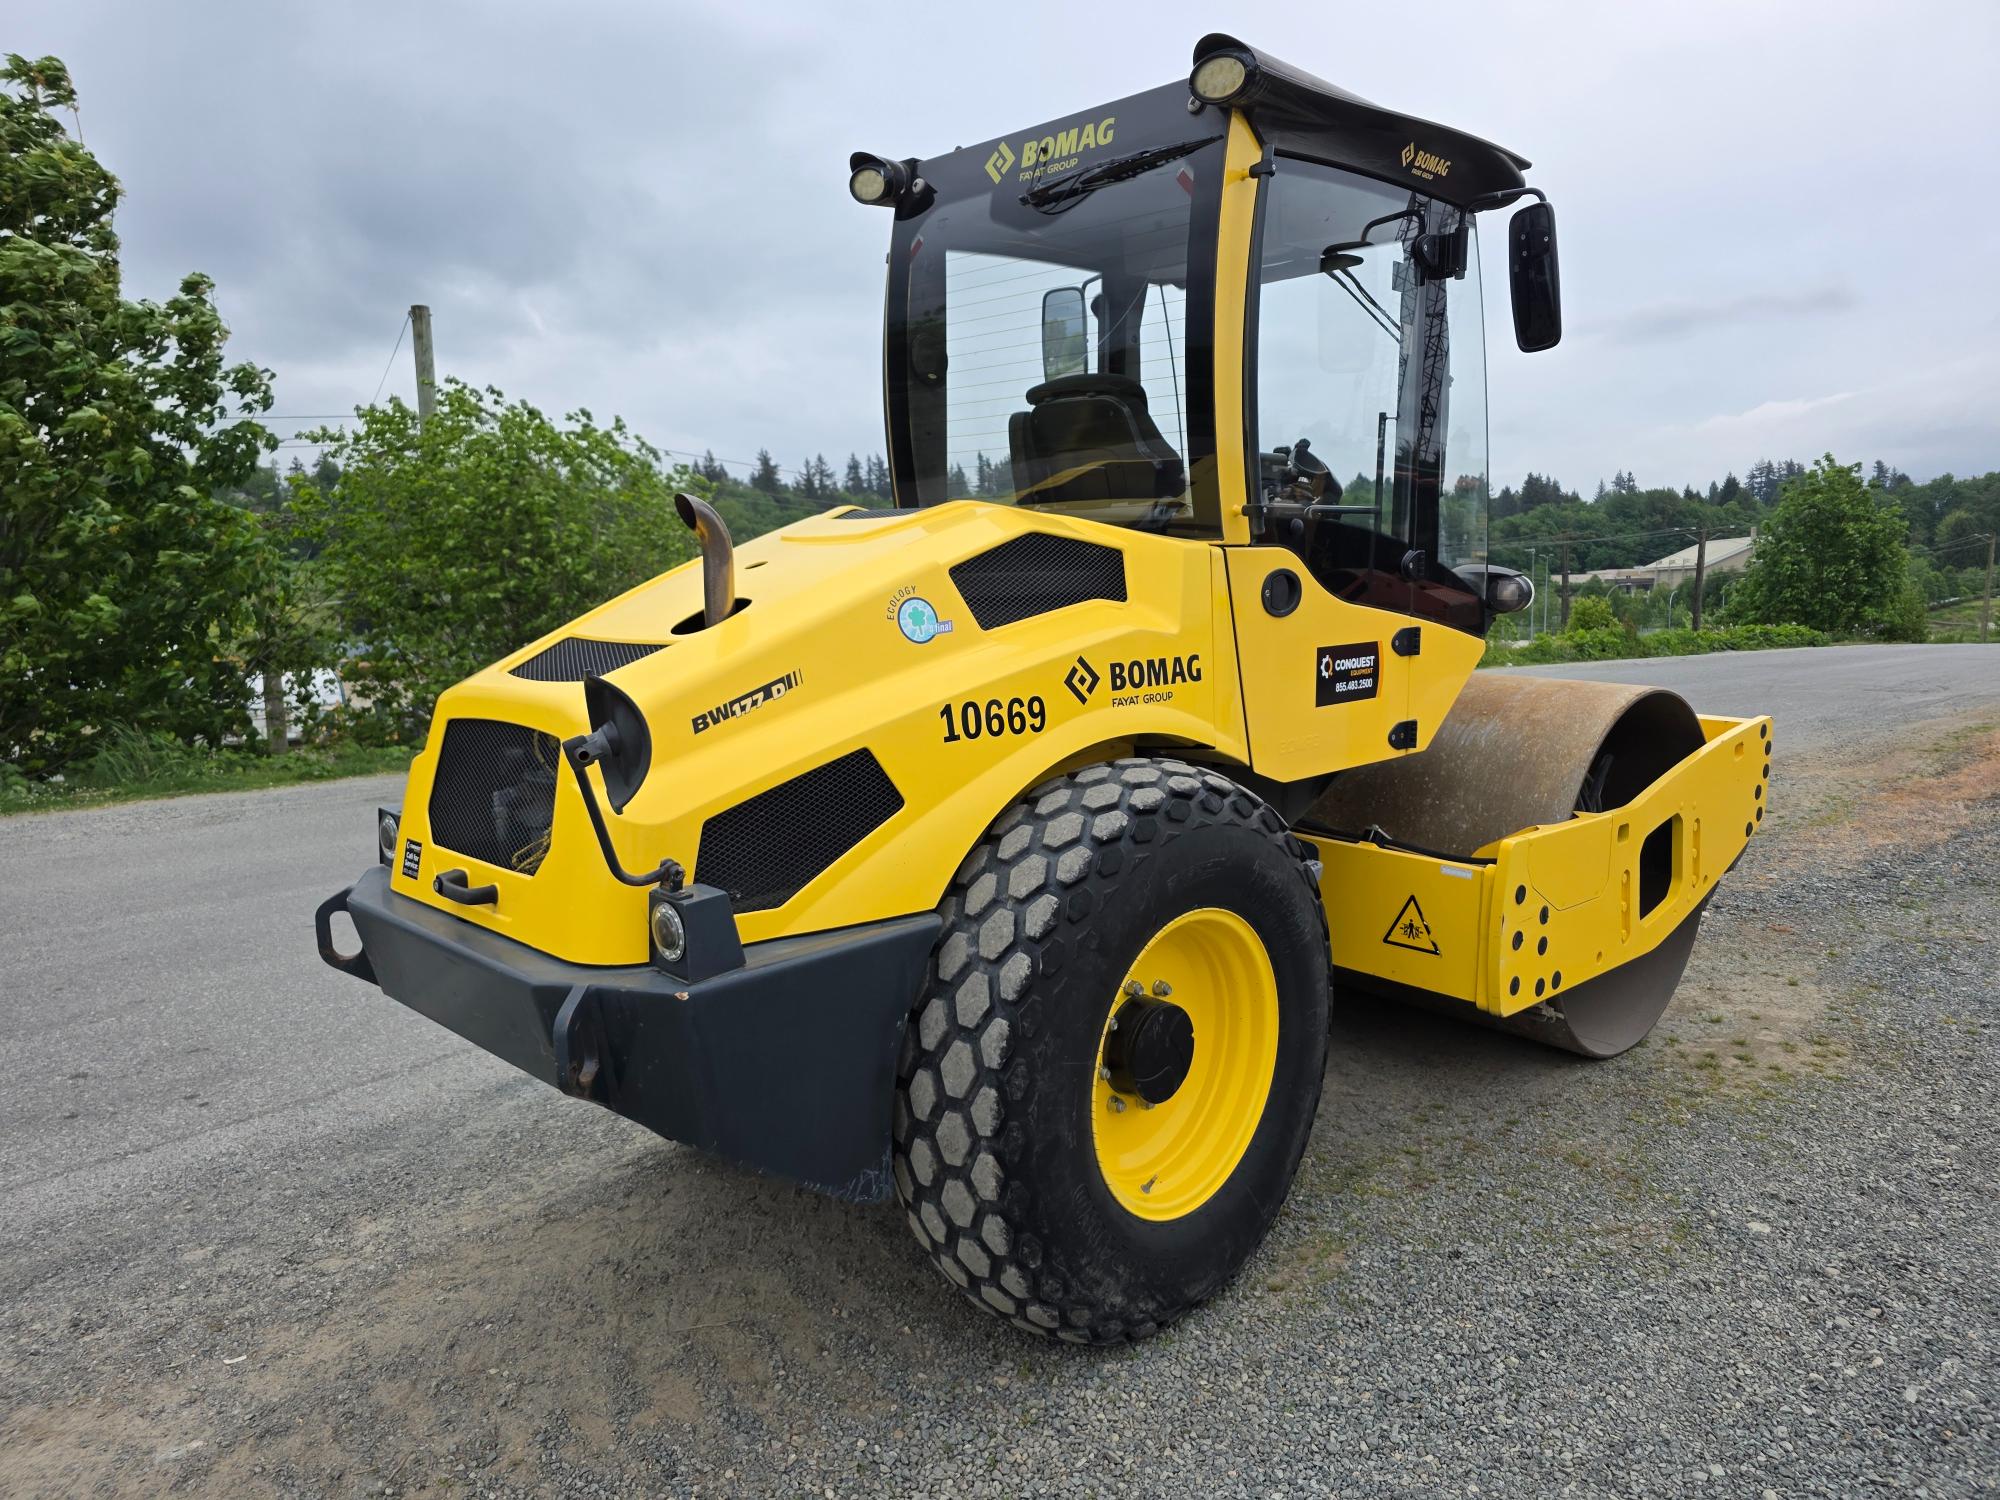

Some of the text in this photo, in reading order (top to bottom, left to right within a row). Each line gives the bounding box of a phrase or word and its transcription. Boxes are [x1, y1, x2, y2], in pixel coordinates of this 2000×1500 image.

[1021, 118, 1115, 168] BOMAG
[1019, 158, 1078, 181] FAYAT GROUP
[1414, 150, 1451, 177] BOMAG
[887, 585, 916, 621] ECOLOGY
[1110, 654, 1202, 691] BOMAG
[1335, 656, 1375, 671] CONQUEST
[1335, 678, 1373, 693] 855.483.2500
[1112, 691, 1174, 708] FAYAT GROUP
[940, 696, 1046, 743] 10669
